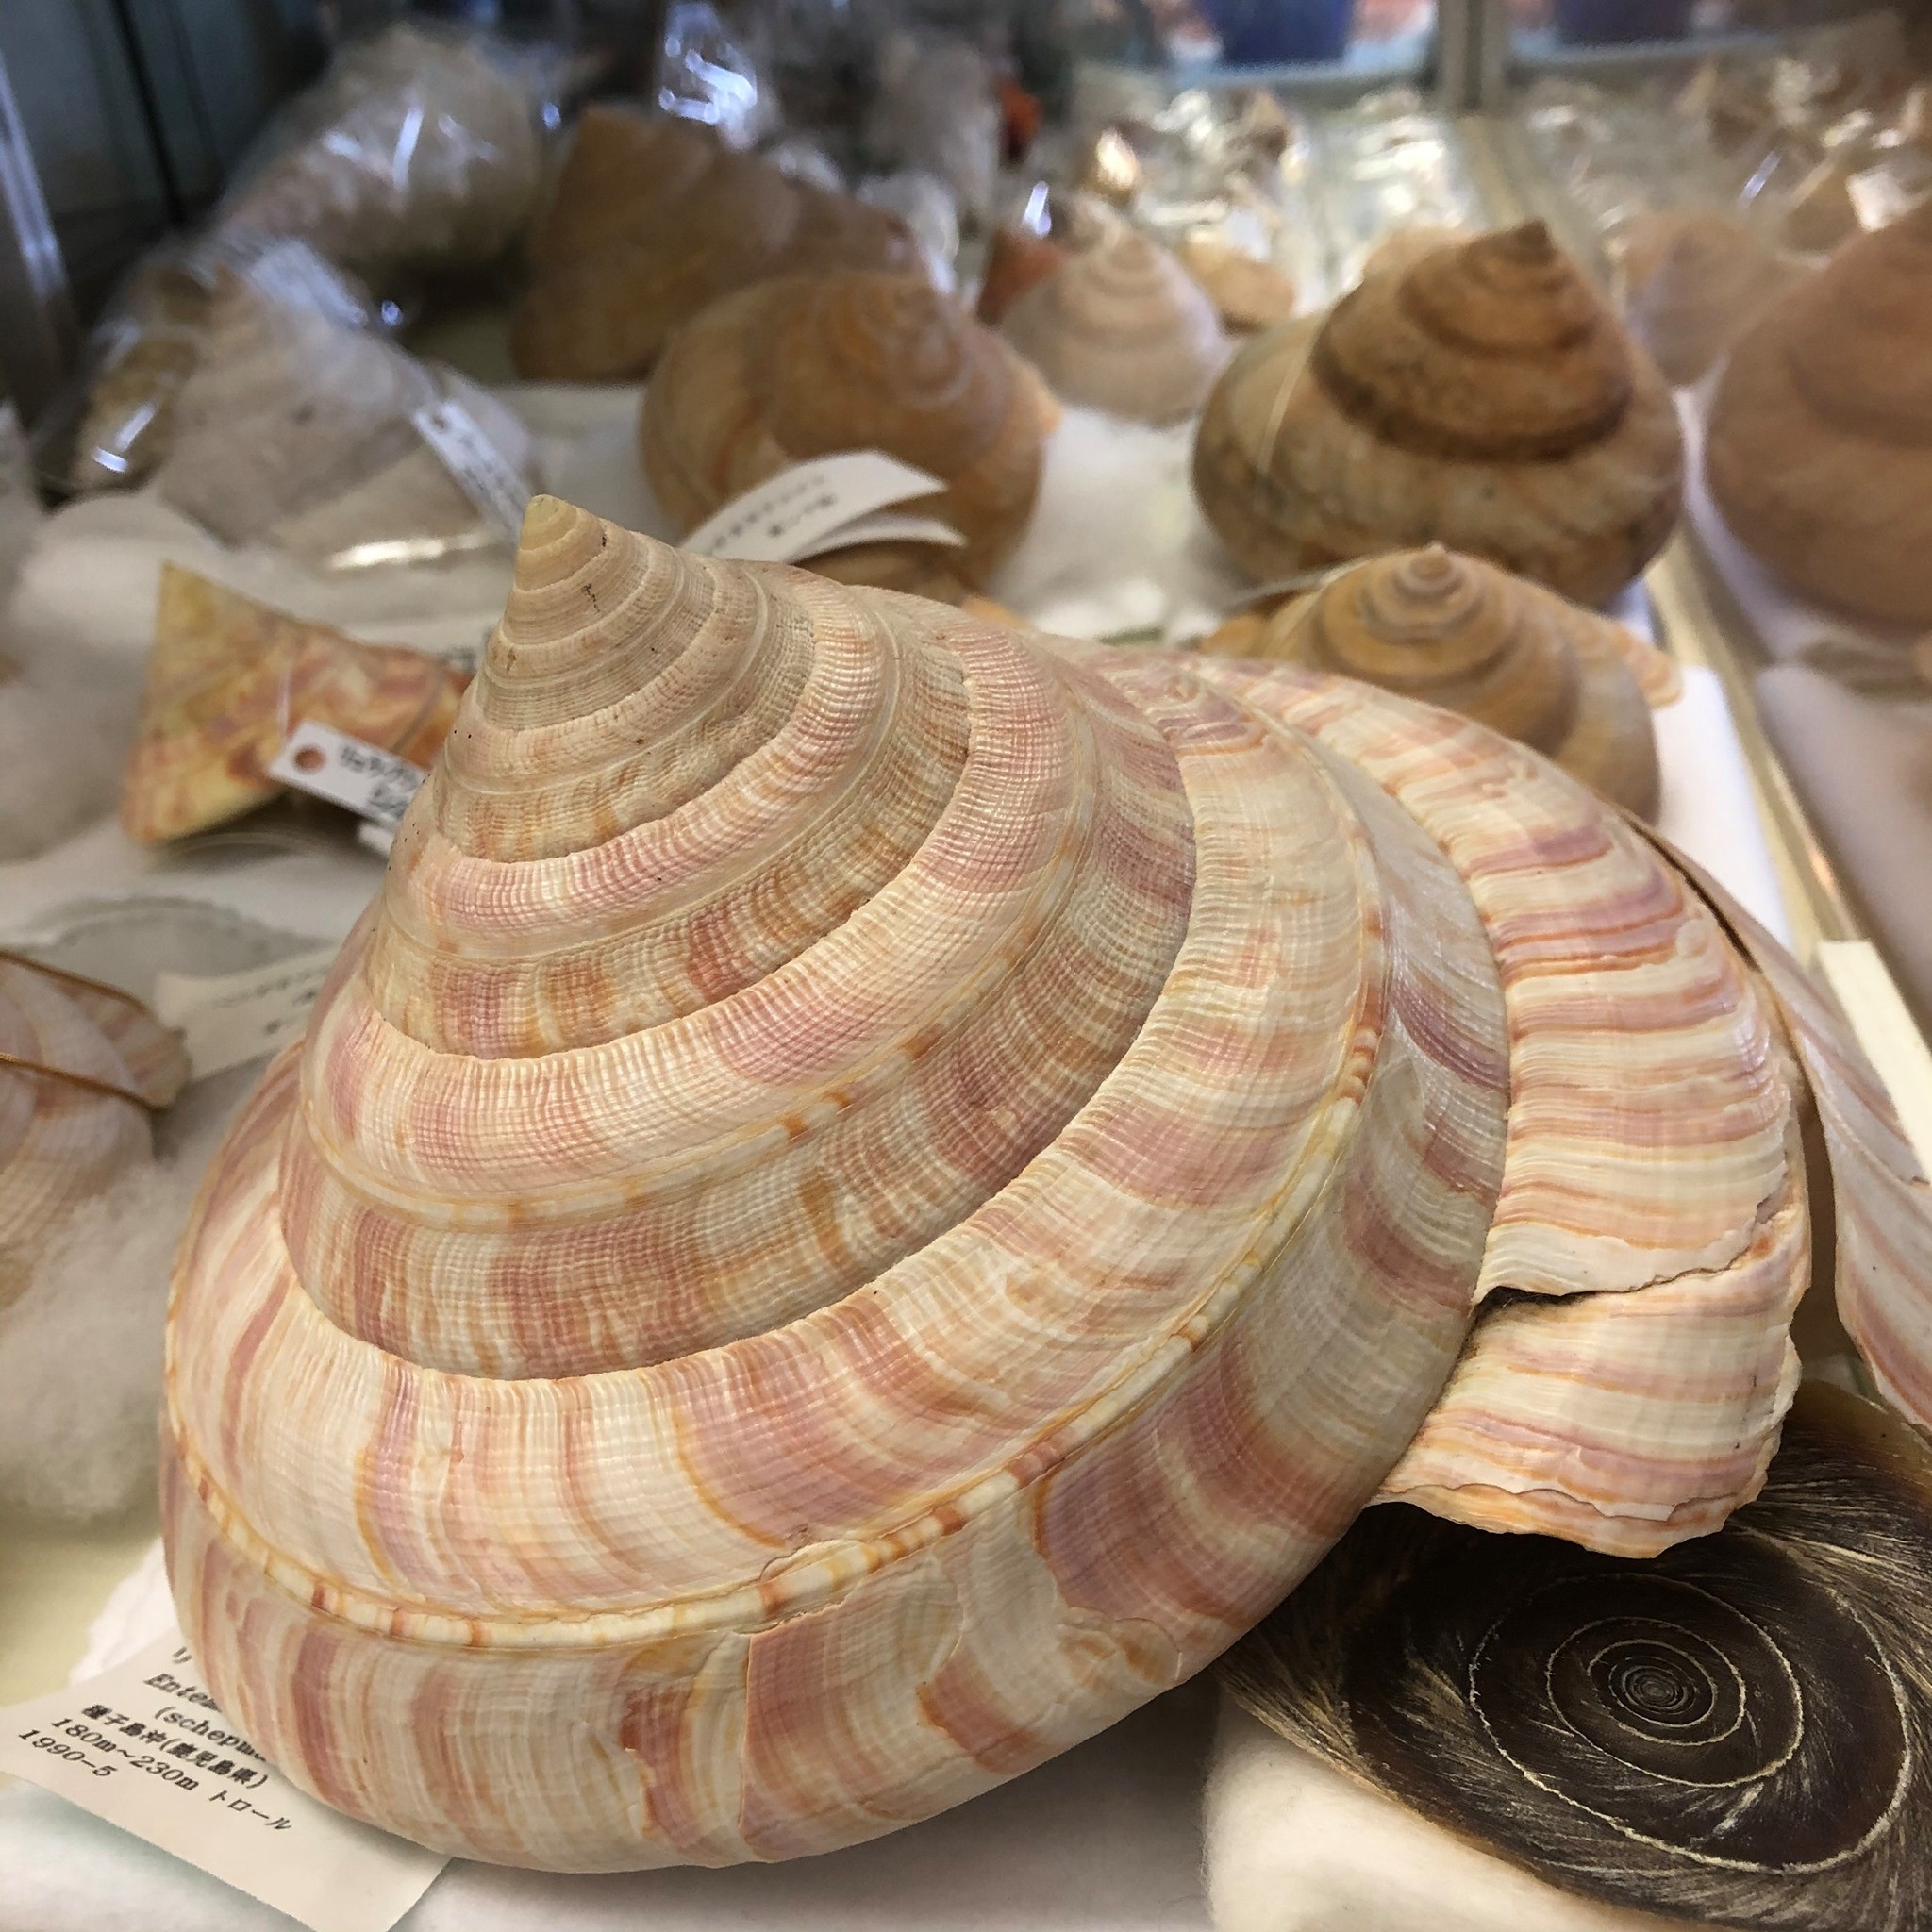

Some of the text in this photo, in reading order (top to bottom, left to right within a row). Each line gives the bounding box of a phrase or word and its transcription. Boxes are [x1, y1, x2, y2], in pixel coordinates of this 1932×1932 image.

[19, 1729, 118, 1777] 1990-5
[208, 1790, 291, 1830] トロール
